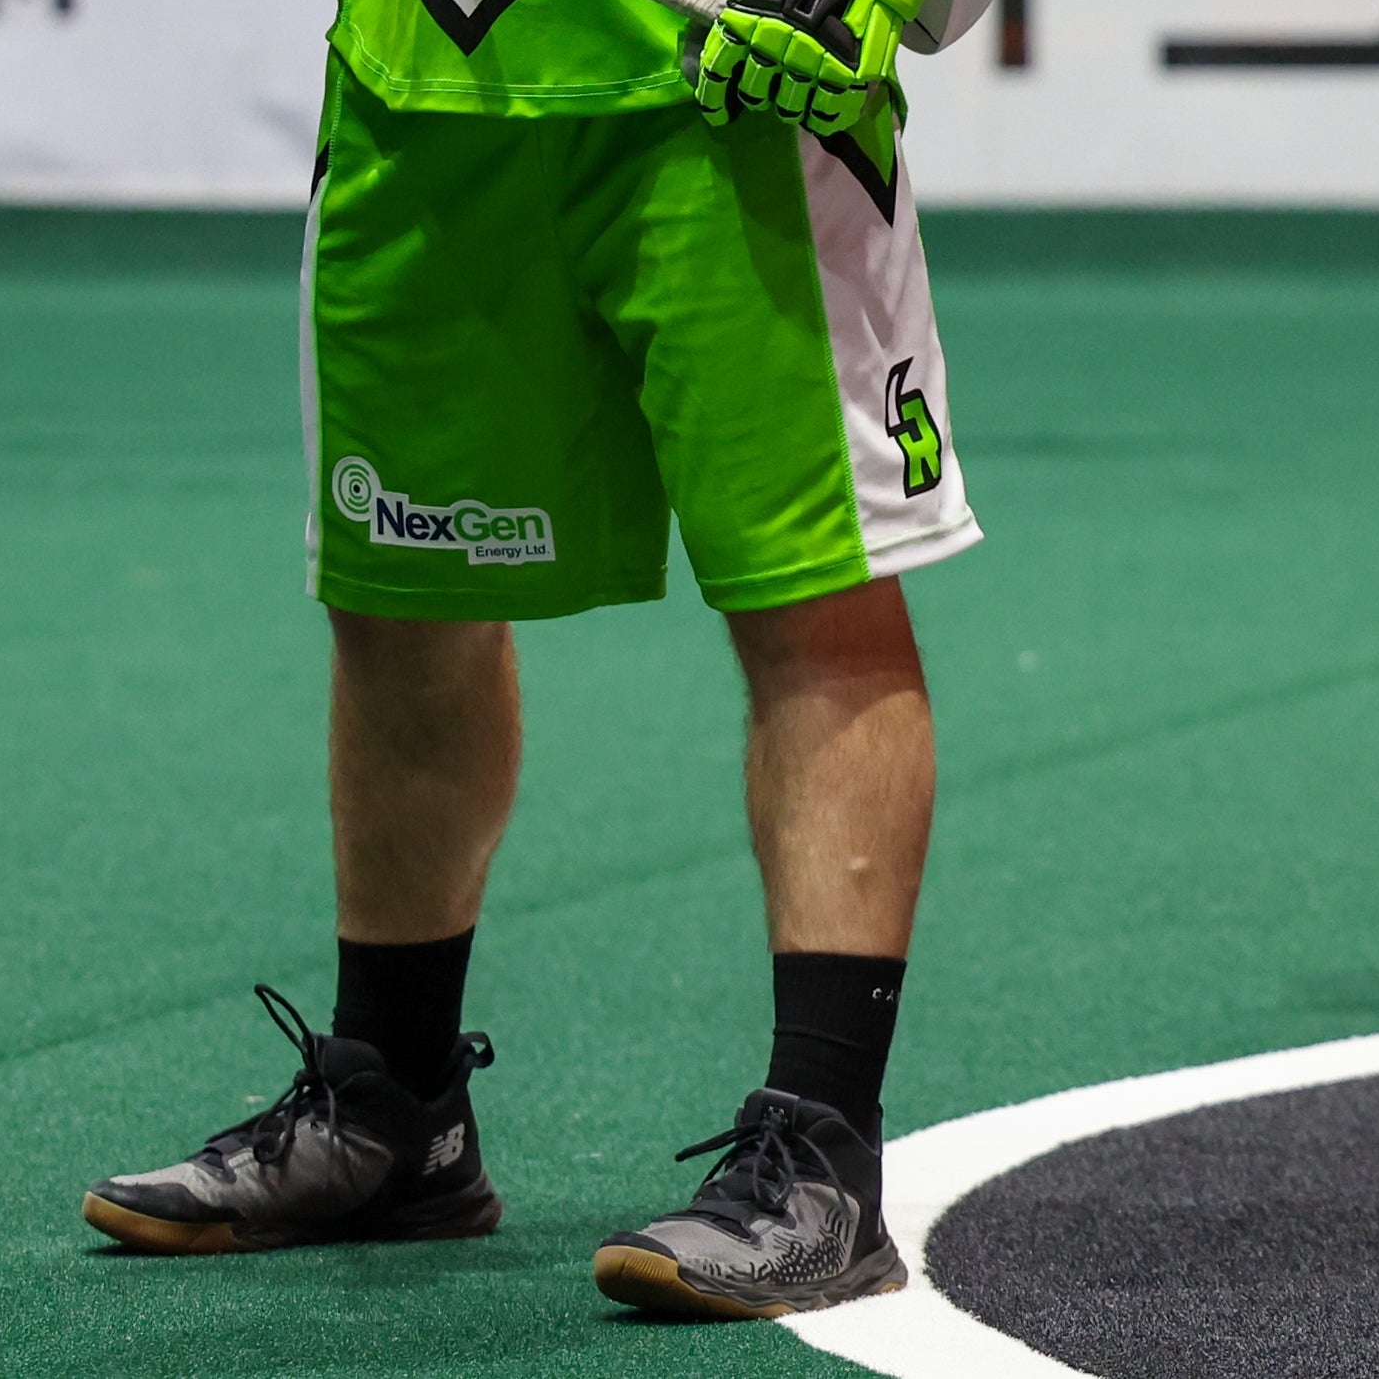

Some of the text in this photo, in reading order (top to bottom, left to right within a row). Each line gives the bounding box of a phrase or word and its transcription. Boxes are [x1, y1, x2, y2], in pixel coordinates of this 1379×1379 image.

[376, 497, 545, 542] NexGen
[475, 543, 551, 559] Energy Ltd.
